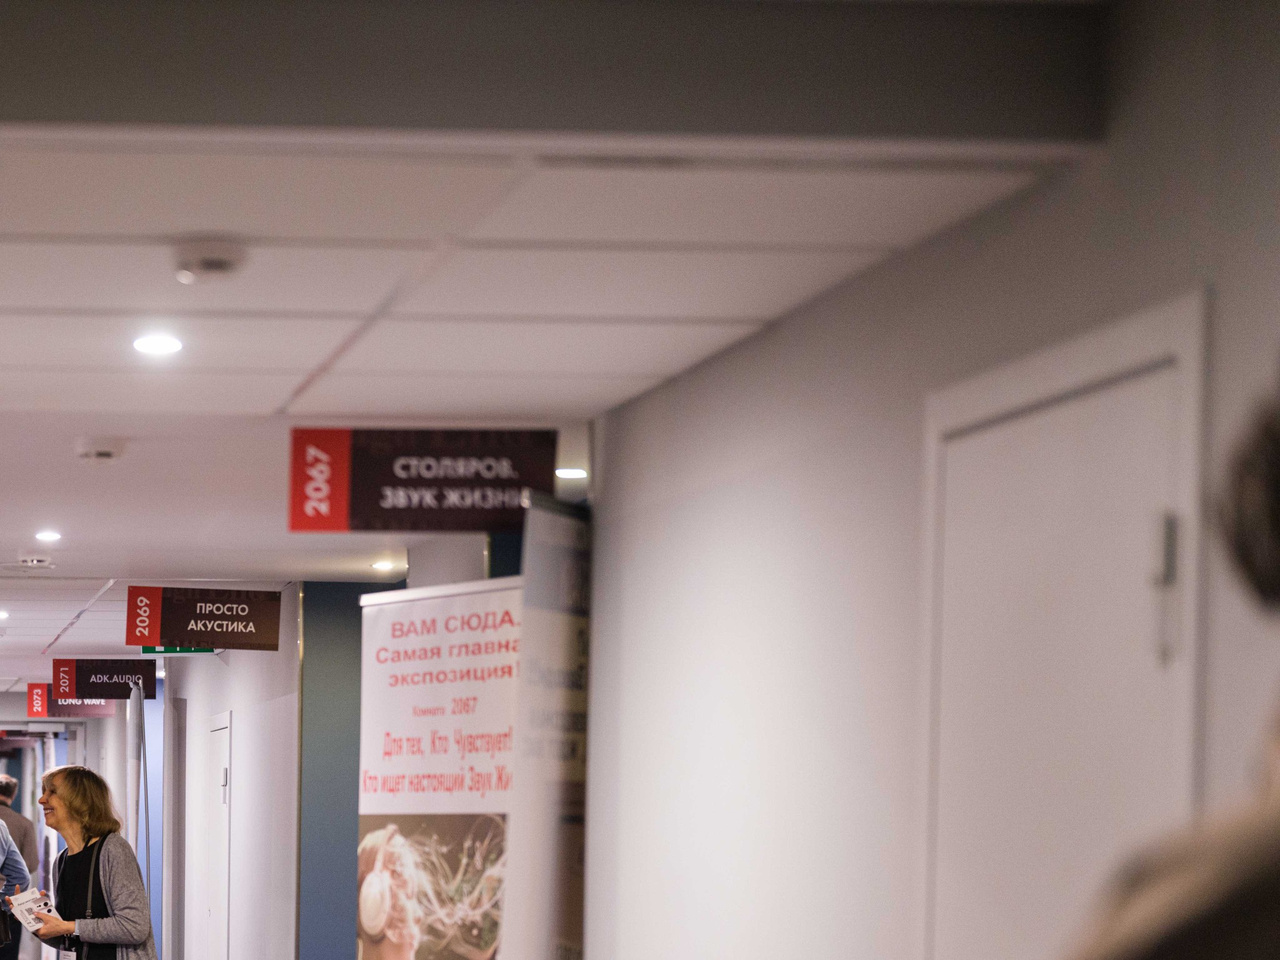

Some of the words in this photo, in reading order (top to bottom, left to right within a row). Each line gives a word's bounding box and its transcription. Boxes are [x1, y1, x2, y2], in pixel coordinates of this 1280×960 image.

[304, 445, 332, 518] 2067
[379, 486, 439, 510] ЗВУК
[135, 595, 150, 637] 2069
[196, 603, 250, 616] ПРОСТО
[187, 619, 256, 634] АКУСТИКА
[390, 618, 437, 640] ВАМ
[375, 644, 442, 665] Самая
[59, 667, 70, 693] 2071
[89, 674, 144, 683] ADK.AUDIO
[33, 688, 42, 712] 2073
[57, 698, 82, 706] LONG
[83, 698, 106, 706] WAVE
[451, 696, 479, 716] 2067
[382, 732, 402, 760] Для
[430, 729, 449, 756] Кто
[362, 769, 379, 794] Кто
[381, 774, 406, 796] ищет
[407, 767, 466, 794] настоящий
[467, 765, 492, 799] Звук
